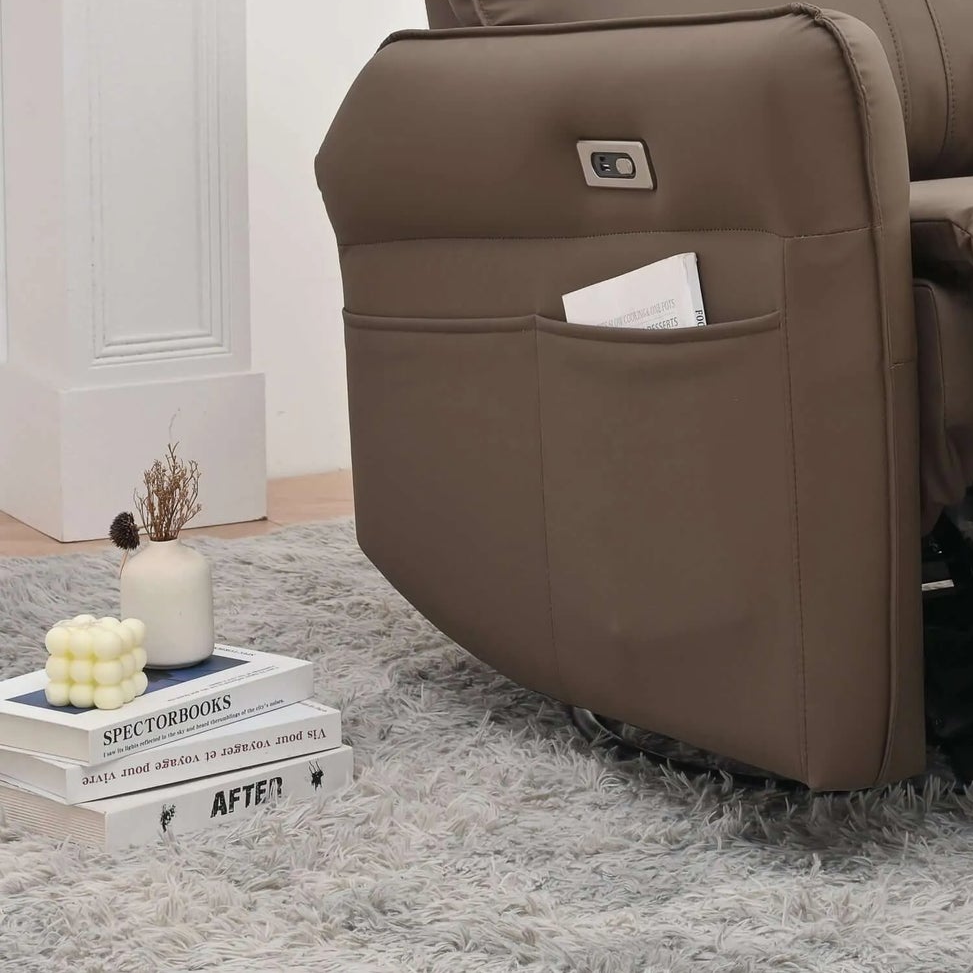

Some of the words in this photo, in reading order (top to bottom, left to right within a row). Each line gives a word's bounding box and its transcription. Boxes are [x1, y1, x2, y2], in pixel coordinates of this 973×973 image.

[103, 694, 232, 746] SPECTORBOOKS
[177, 728, 185, 736] sky
[275, 730, 303, 745] pour
[307, 727, 326, 740] Vis
[221, 739, 271, 757] voyager
[154, 754, 200, 771] voyage
[204, 751, 217, 763] et
[120, 763, 151, 778] pour
[81, 772, 116, 787] vivre
[210, 776, 283, 818] AFTER
